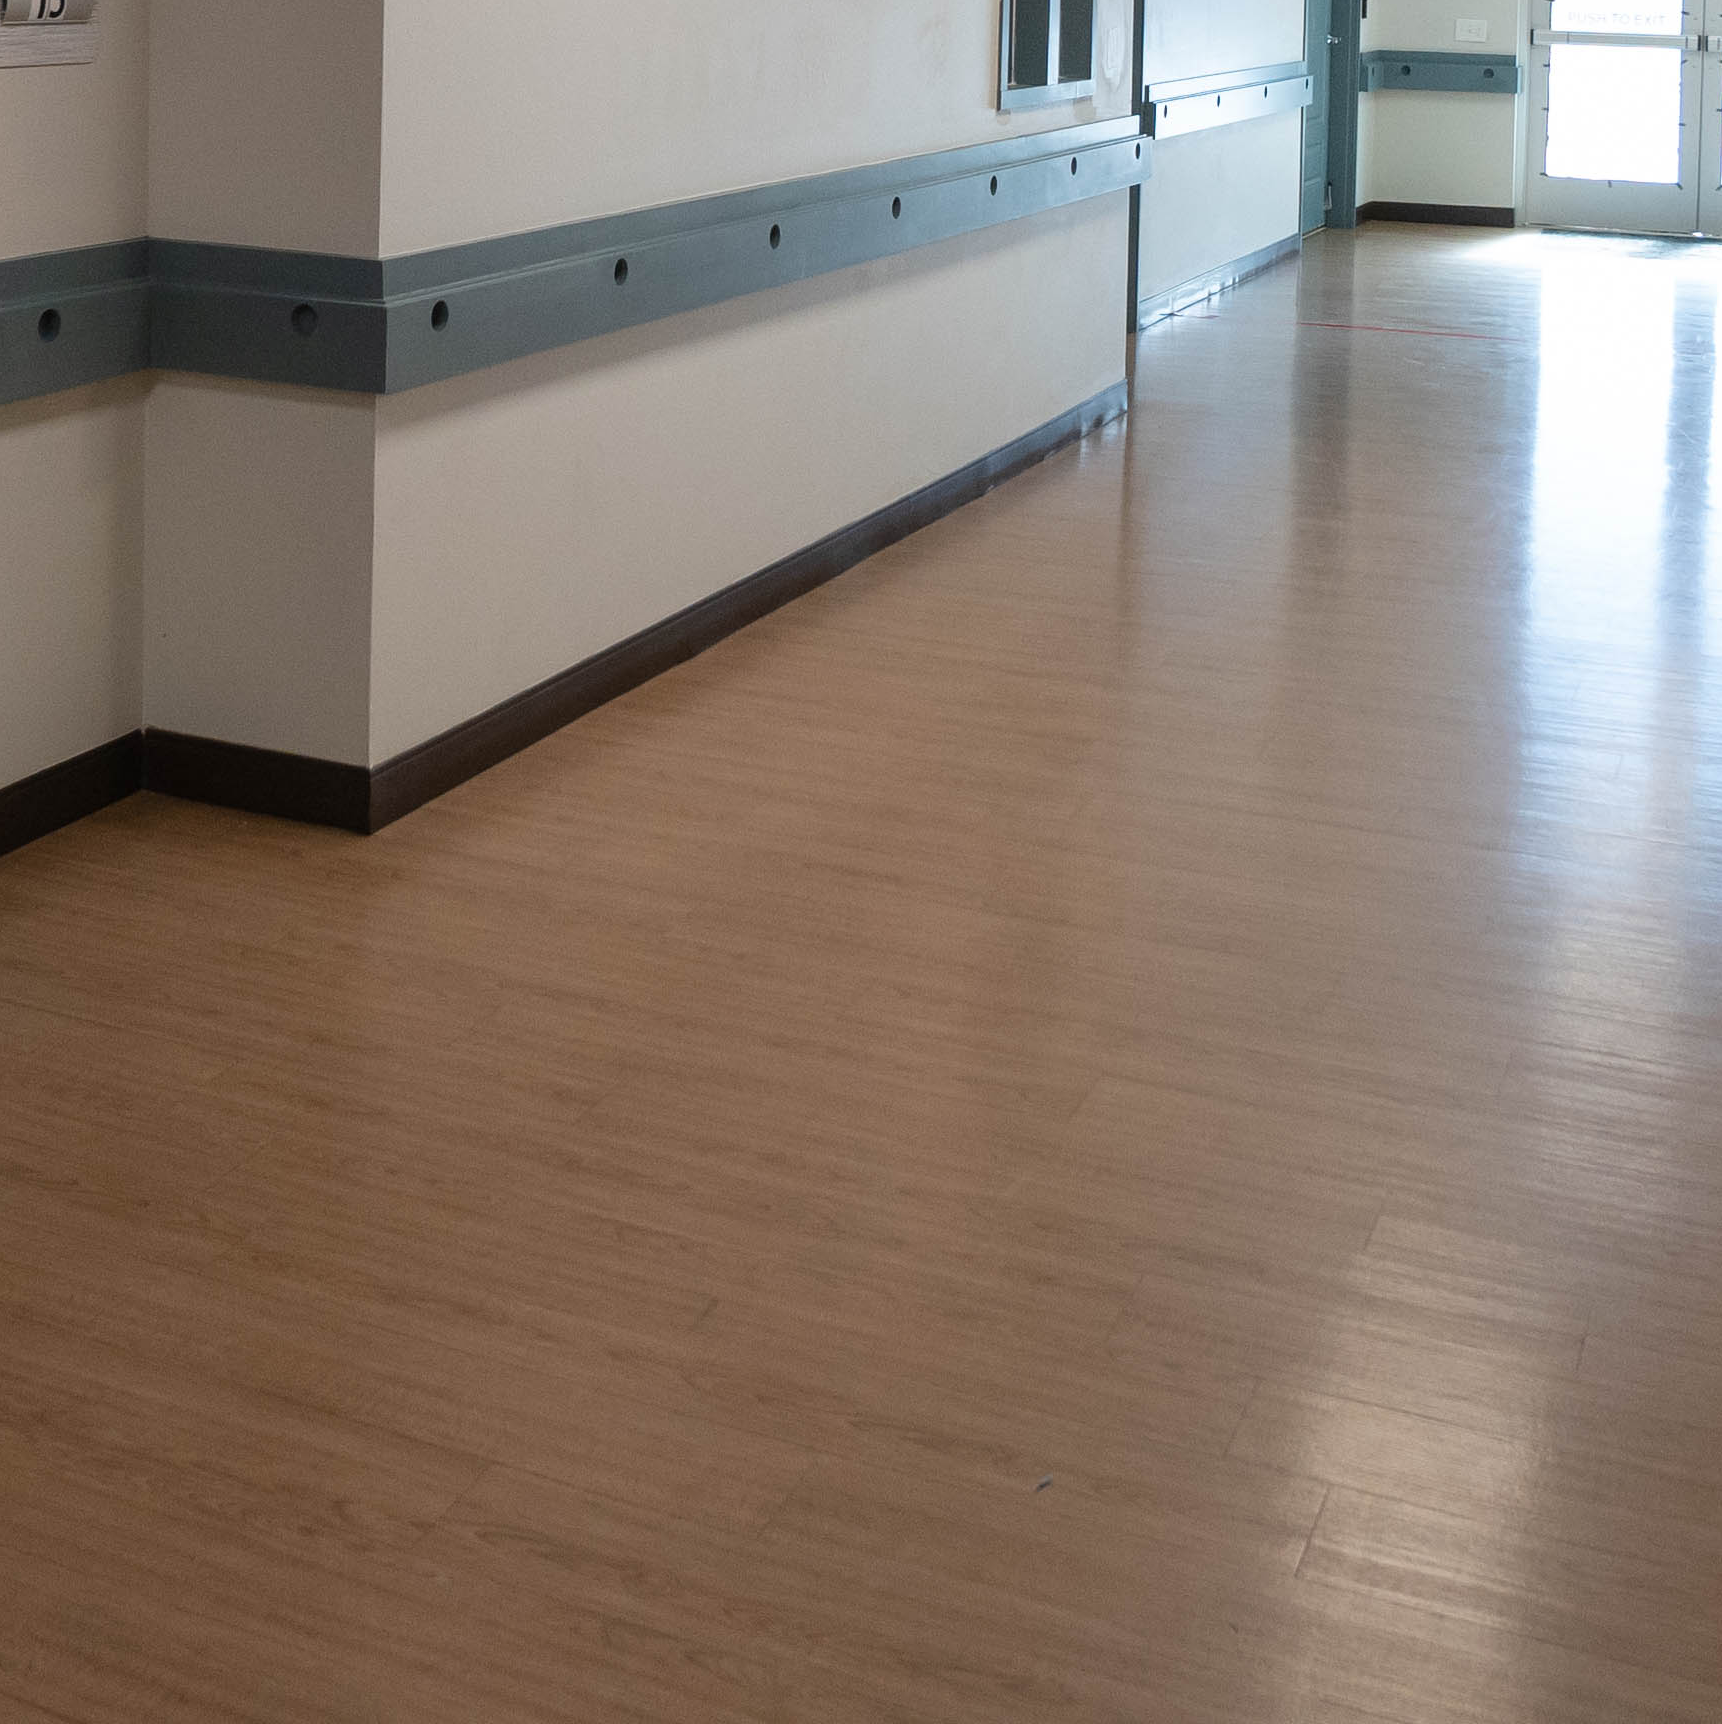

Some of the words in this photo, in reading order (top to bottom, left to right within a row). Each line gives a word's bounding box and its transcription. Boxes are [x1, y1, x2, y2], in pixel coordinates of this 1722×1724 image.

[1567, 12, 1606, 25] PUSH
[1612, 13, 1630, 25] TO
[1635, 14, 1667, 27] EXIT
